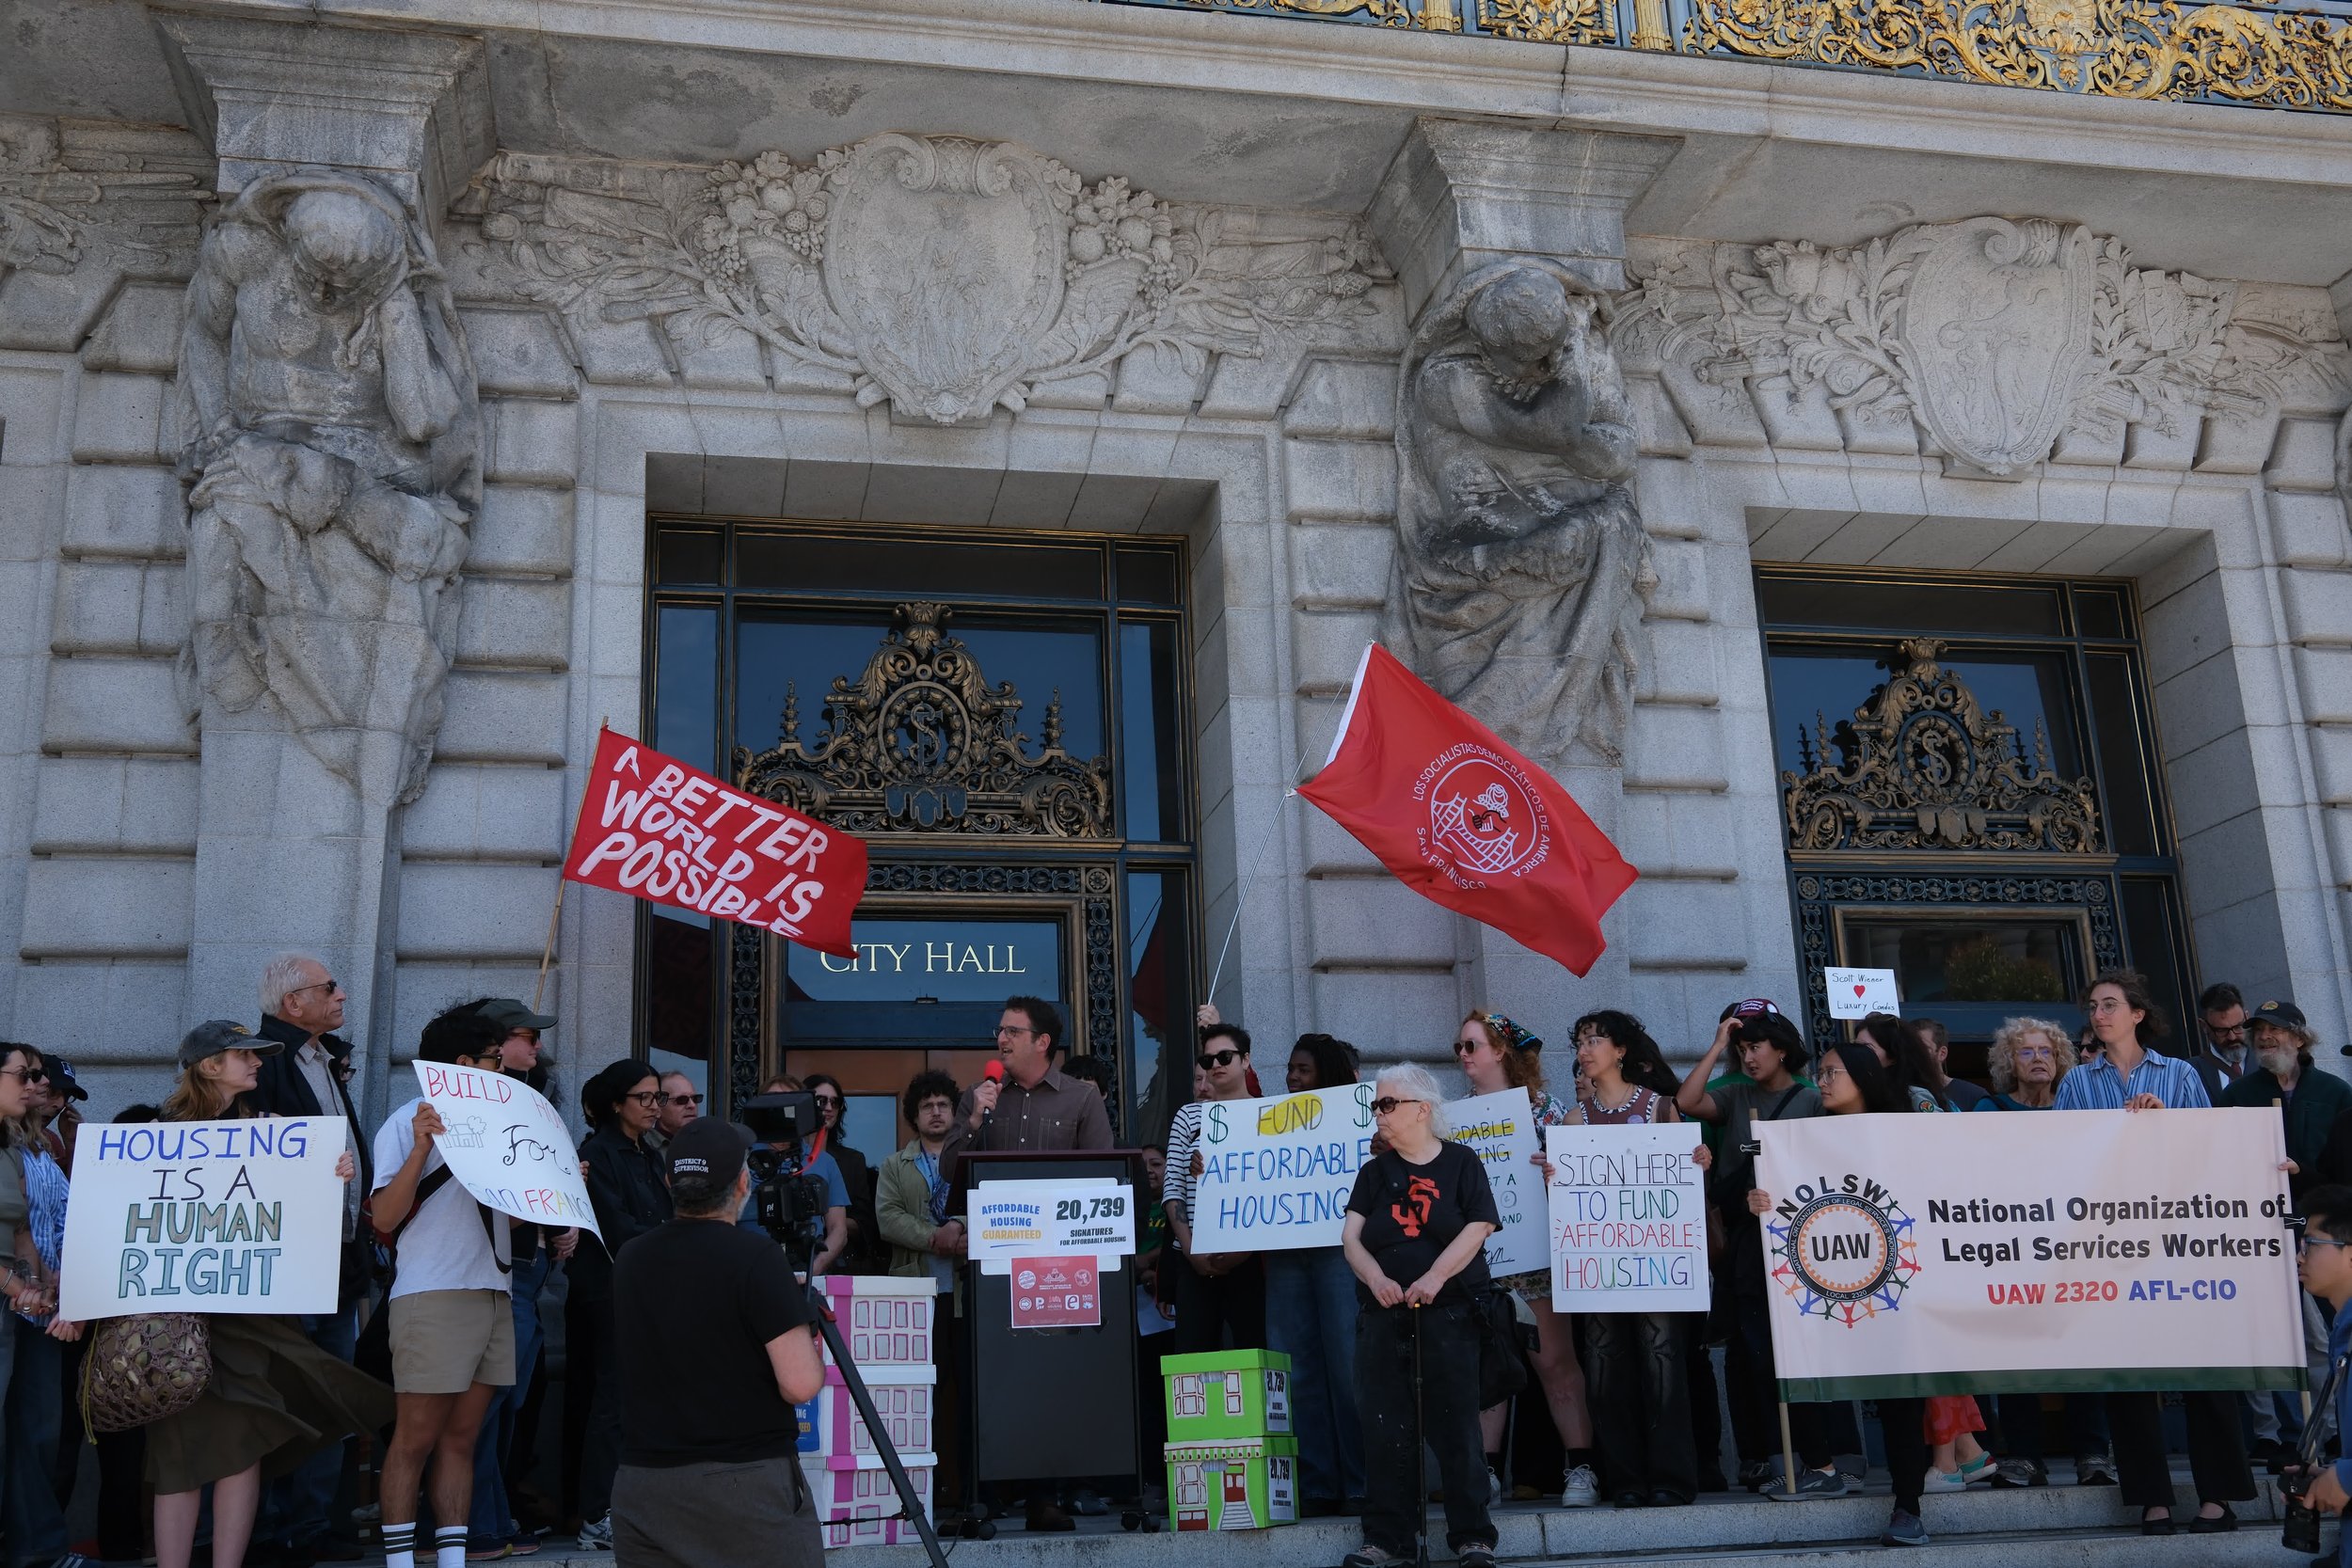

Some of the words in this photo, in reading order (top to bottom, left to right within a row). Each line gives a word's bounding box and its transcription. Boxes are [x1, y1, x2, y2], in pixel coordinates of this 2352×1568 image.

[1420, 743, 1476, 783] SOCIALISTAS
[1476, 746, 1544, 813] DEMOCRÁTICOS
[1413, 780, 1426, 800] LOS
[613, 746, 642, 780] A
[648, 763, 830, 873] BETTER
[1539, 815, 1549, 832] DE
[600, 780, 755, 883] WORLD
[764, 872, 824, 923] IS
[1417, 827, 1428, 856] SAN
[1428, 854, 1486, 890] FRANCISCO
[1512, 835, 1550, 878] AMÉRICA
[578, 832, 804, 939] POSSIBLE
[819, 943, 912, 973] CITY
[925, 942, 1026, 974] HALL
[1832, 973, 1854, 983] Scott
[1857, 974, 1884, 983] Wiener
[1836, 1001, 1867, 1012] Luxury
[426, 1067, 512, 1104] BUILD
[1207, 1103, 1229, 1145] $
[1257, 1099, 1324, 1136] FUND
[1449, 1118, 1514, 1145] RDABLE
[99, 1122, 309, 1161] HOUSING
[501, 1125, 571, 1175] For
[674, 1165, 708, 1174] SUPERVISOR
[675, 1158, 701, 1166] DISTRICT
[1201, 1137, 1372, 1187] AFFORDABLE
[1558, 1153, 1625, 1185] SIGN
[1635, 1153, 1693, 1184] HERE
[148, 1167, 204, 1200] IS
[225, 1164, 256, 1200] A
[1775, 1174, 1889, 1222] NOLSW
[524, 1188, 596, 1227] FRANC
[981, 1203, 1041, 1215] AFFORDABLE
[1056, 1196, 1125, 1225] 20,739
[1219, 1187, 1349, 1229] HOUSING
[1569, 1191, 1607, 1222] TO
[1619, 1189, 1679, 1220] FUND
[1791, 1199, 1830, 1238] ORGANIZATION
[1842, 1198, 1863, 1209] LEGAL
[1864, 1206, 1890, 1234] SERVICES
[1927, 1196, 2056, 1224] National
[2066, 1193, 2249, 1226] Organization
[2261, 1193, 2286, 1218] of
[124, 1201, 281, 1243] HUMAN
[982, 1229, 1041, 1240] GUARANTEED
[990, 1217, 1032, 1227] HOUSING
[1070, 1227, 1113, 1238] SIGNATURES
[1560, 1223, 1693, 1248] AFFORDABLE
[1071, 1237, 1103, 1245] AFFORDABLE
[1790, 1238, 1803, 1272] NATIONAL
[1811, 1233, 1870, 1262] UAW
[1884, 1235, 1895, 1272] WORKERS
[1942, 1236, 2021, 1268] Legal
[2032, 1233, 2151, 1261] Services
[2162, 1232, 2281, 1259] Workers
[118, 1247, 281, 1299] RIGHT
[1565, 1256, 1688, 1289] HOUSING
[1826, 1290, 1849, 1299] LOCAL
[1851, 1290, 1867, 1298] 2320
[1987, 1282, 2046, 1306] UAW
[2054, 1279, 2119, 1304] 2320
[2128, 1278, 2237, 1302] AFL-CIO
[1270, 1458, 1290, 1485] 20,739
